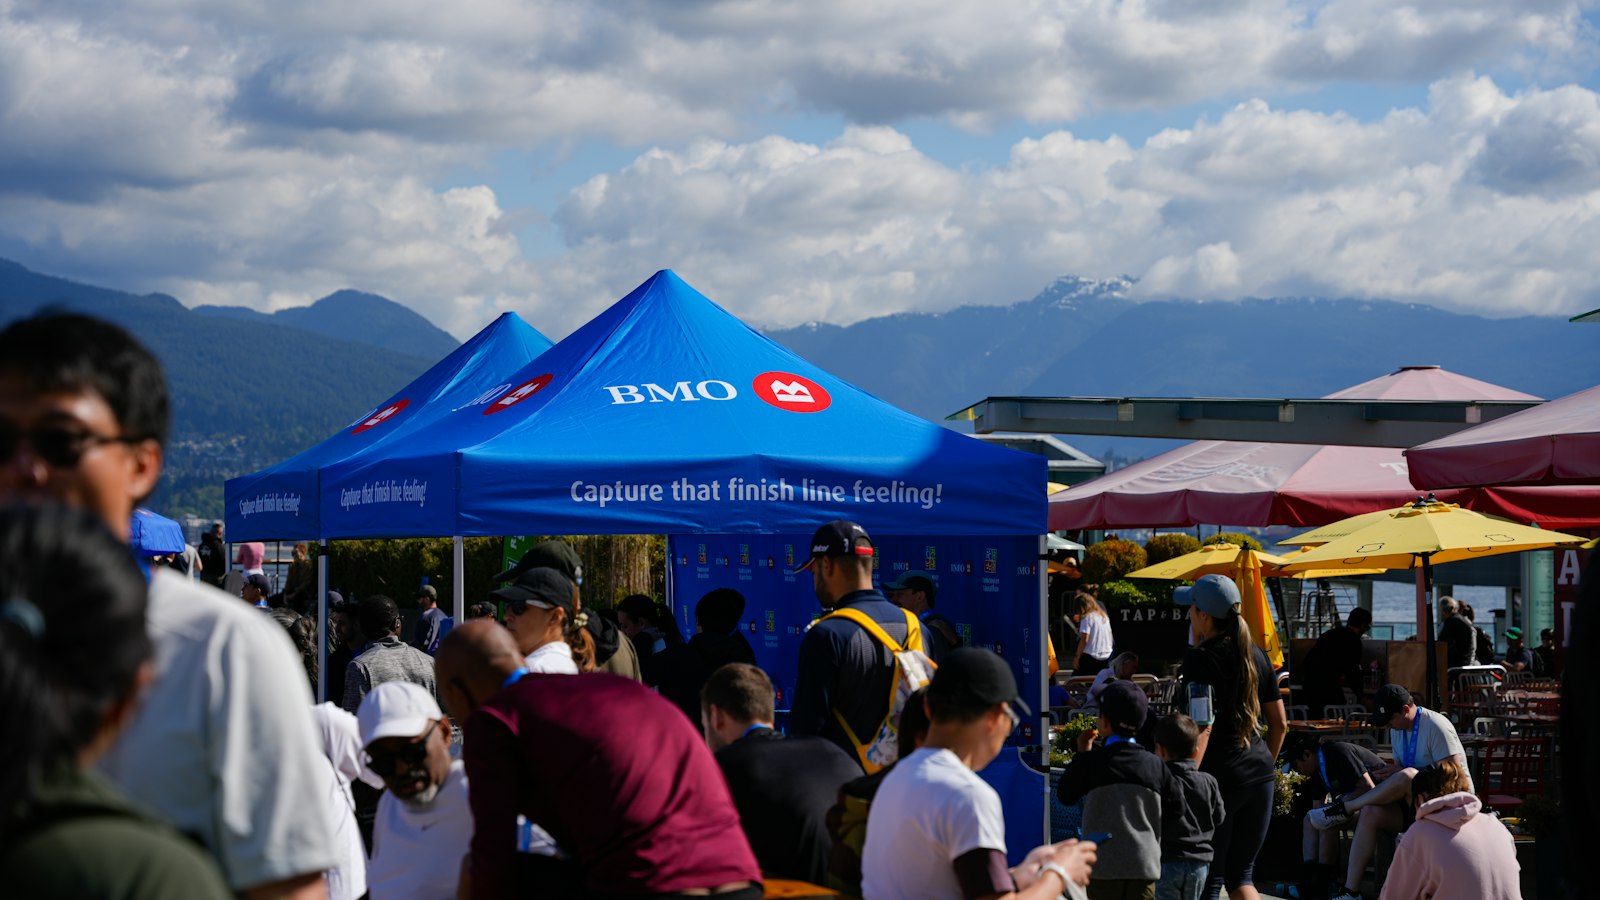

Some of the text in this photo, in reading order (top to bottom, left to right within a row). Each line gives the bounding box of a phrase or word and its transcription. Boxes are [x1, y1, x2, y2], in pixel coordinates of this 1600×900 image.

[603, 380, 738, 405] BMO
[340, 478, 427, 512] Capture that finish line feeling!
[570, 478, 943, 509] Capture that finish line feeling!
[1120, 608, 1156, 621] TAP
